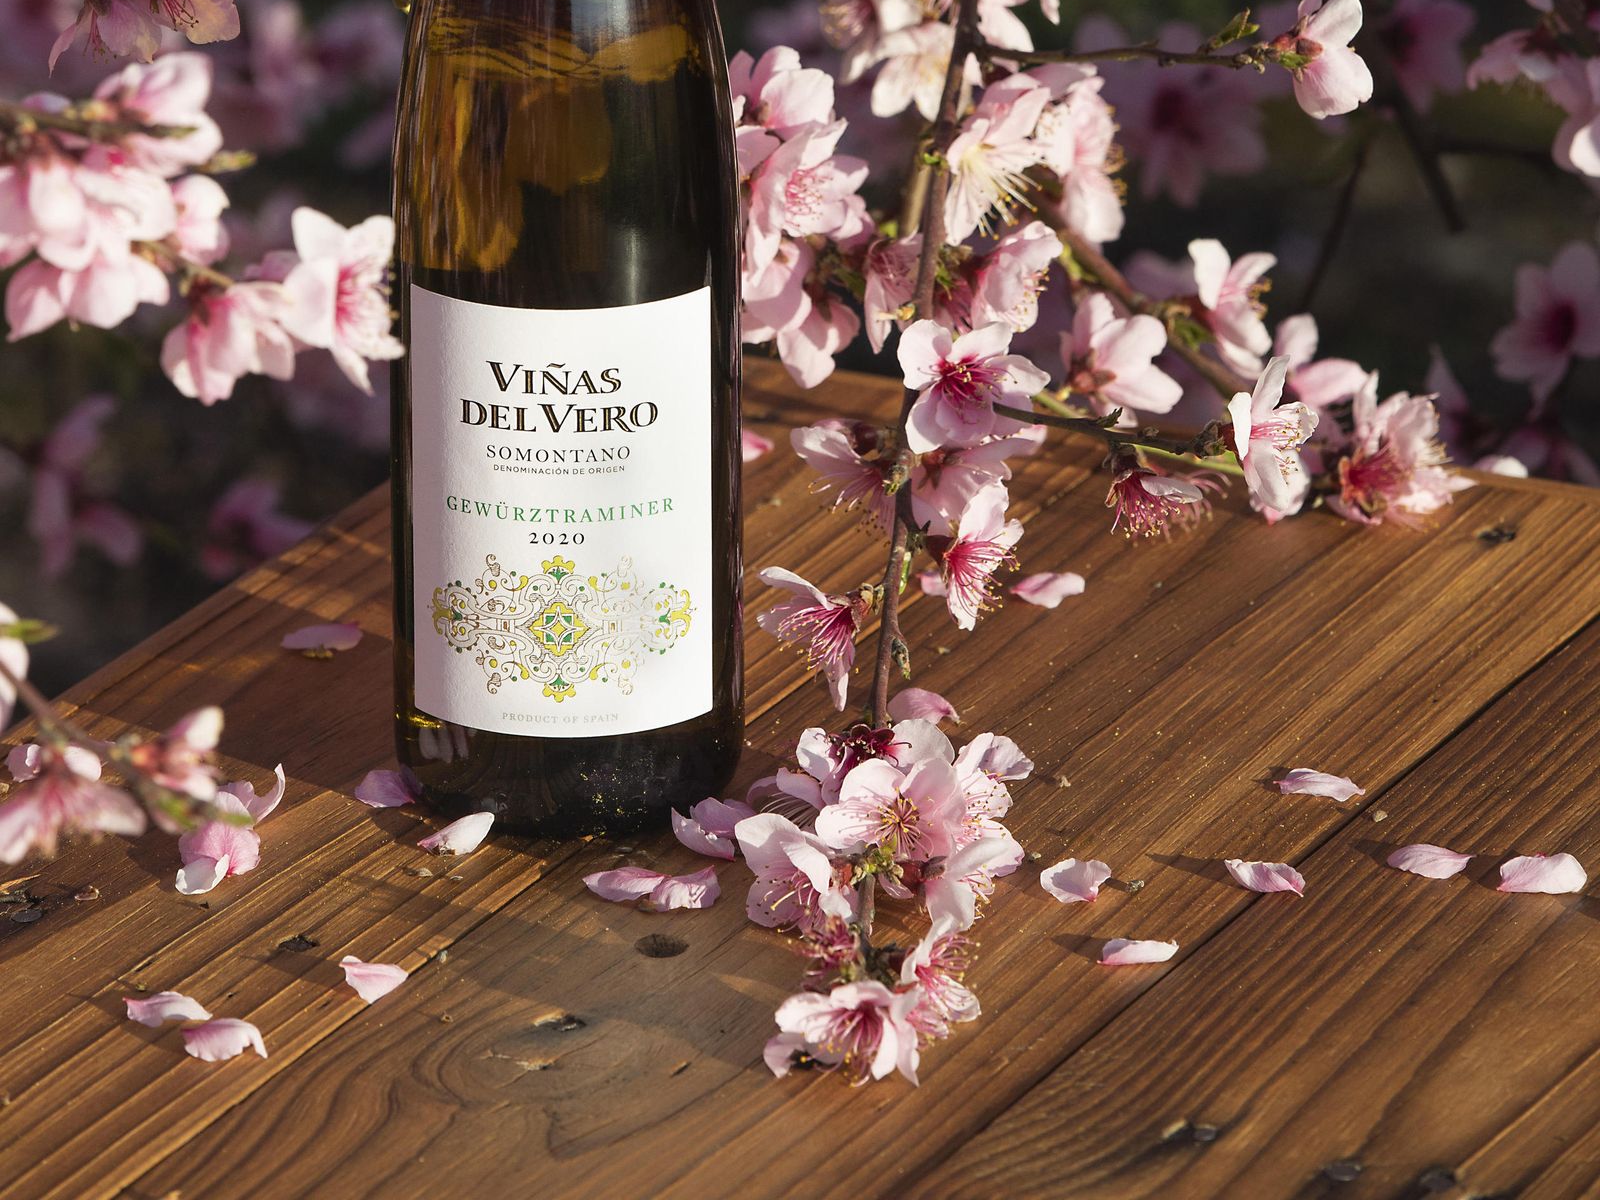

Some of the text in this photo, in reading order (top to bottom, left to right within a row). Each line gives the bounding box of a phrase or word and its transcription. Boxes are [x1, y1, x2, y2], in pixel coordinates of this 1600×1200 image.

[486, 360, 622, 395] VIÑAS
[459, 398, 659, 434] DEL VERO
[486, 443, 631, 464] SOMONTANO
[493, 463, 626, 476] DENOMINACIÓN DE ORIGEN
[446, 495, 674, 524] GEWÜRZTRAMINER
[528, 531, 586, 546] 2020
[502, 711, 619, 725] PRODUCT OF SPAIN
